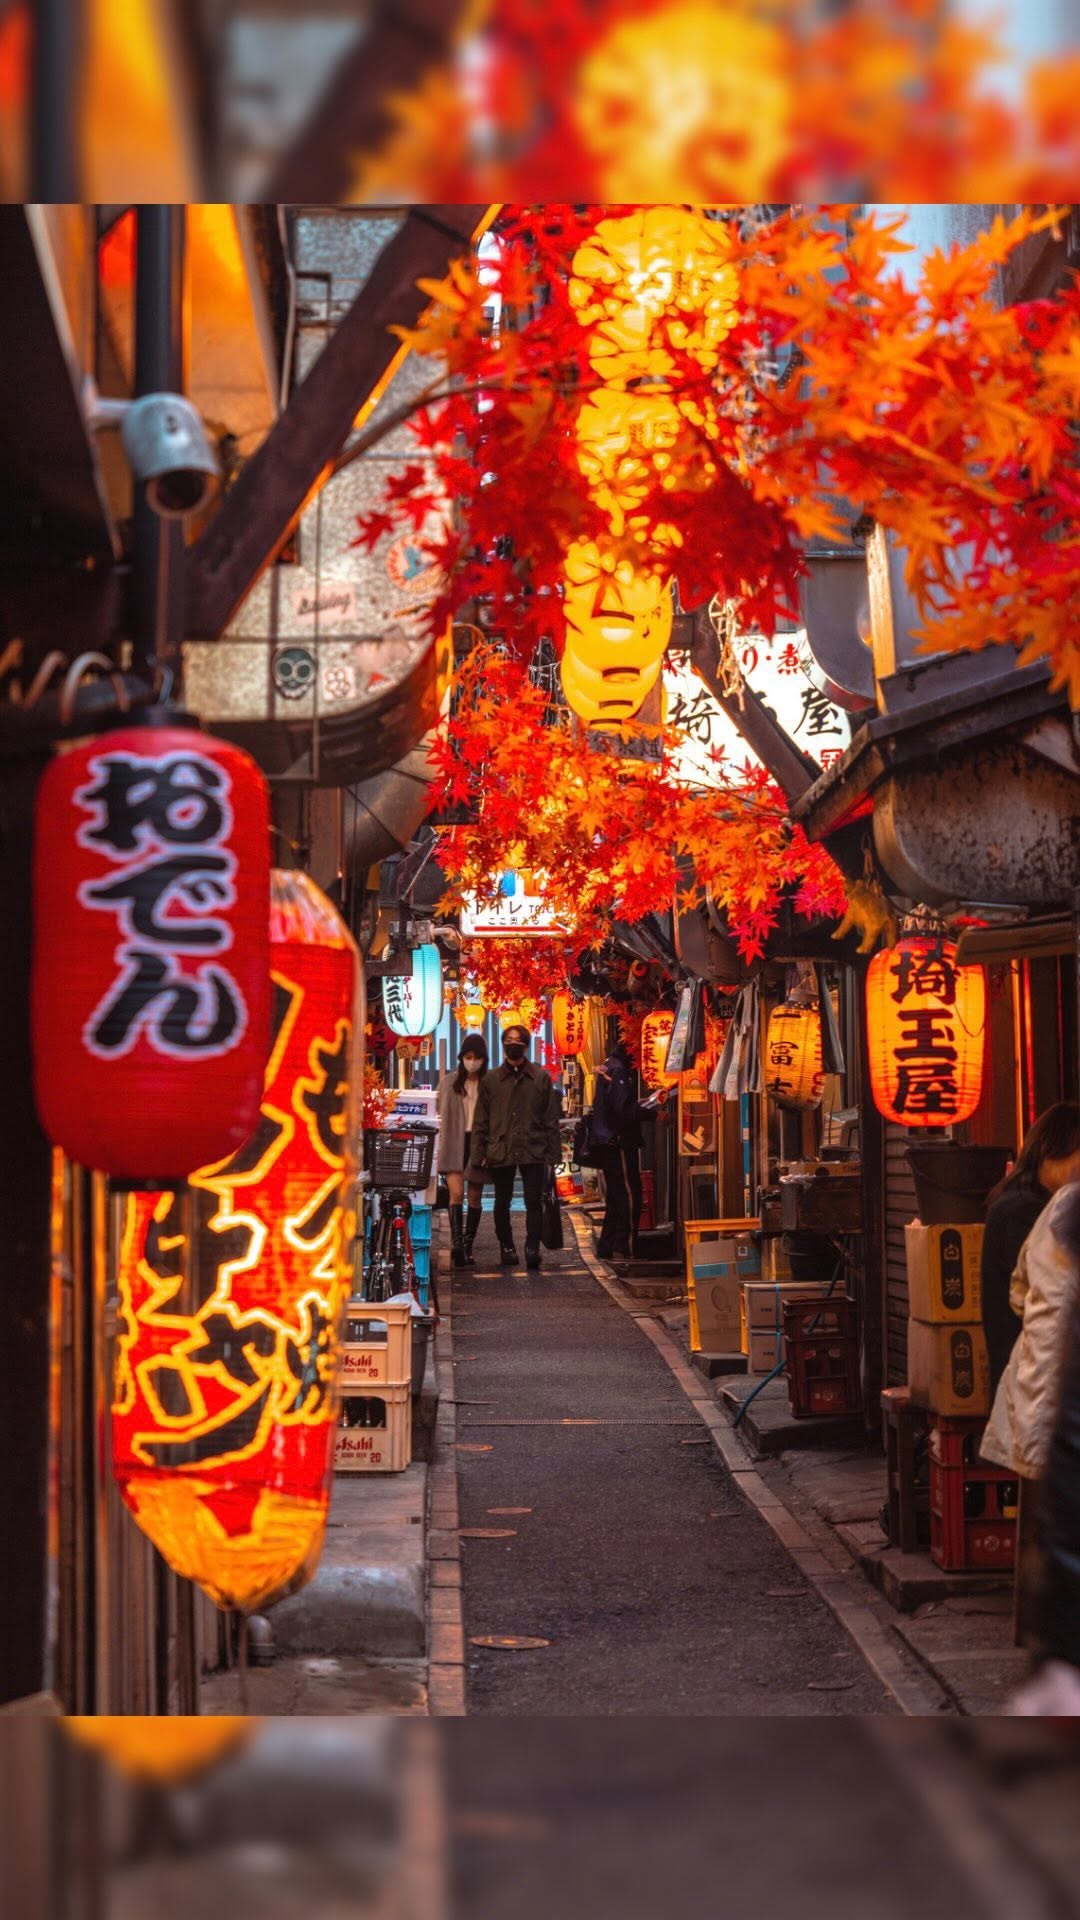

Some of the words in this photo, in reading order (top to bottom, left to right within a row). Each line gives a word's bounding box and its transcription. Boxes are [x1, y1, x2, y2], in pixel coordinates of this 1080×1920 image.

[667, 688, 843, 744] 埼屋
[72, 751, 248, 1061] おでん
[890, 951, 960, 1114] 埼玉屋
[369, 1368, 379, 1378] 20
[336, 1437, 373, 1451] Asahi
[370, 1453, 381, 1463] 20
